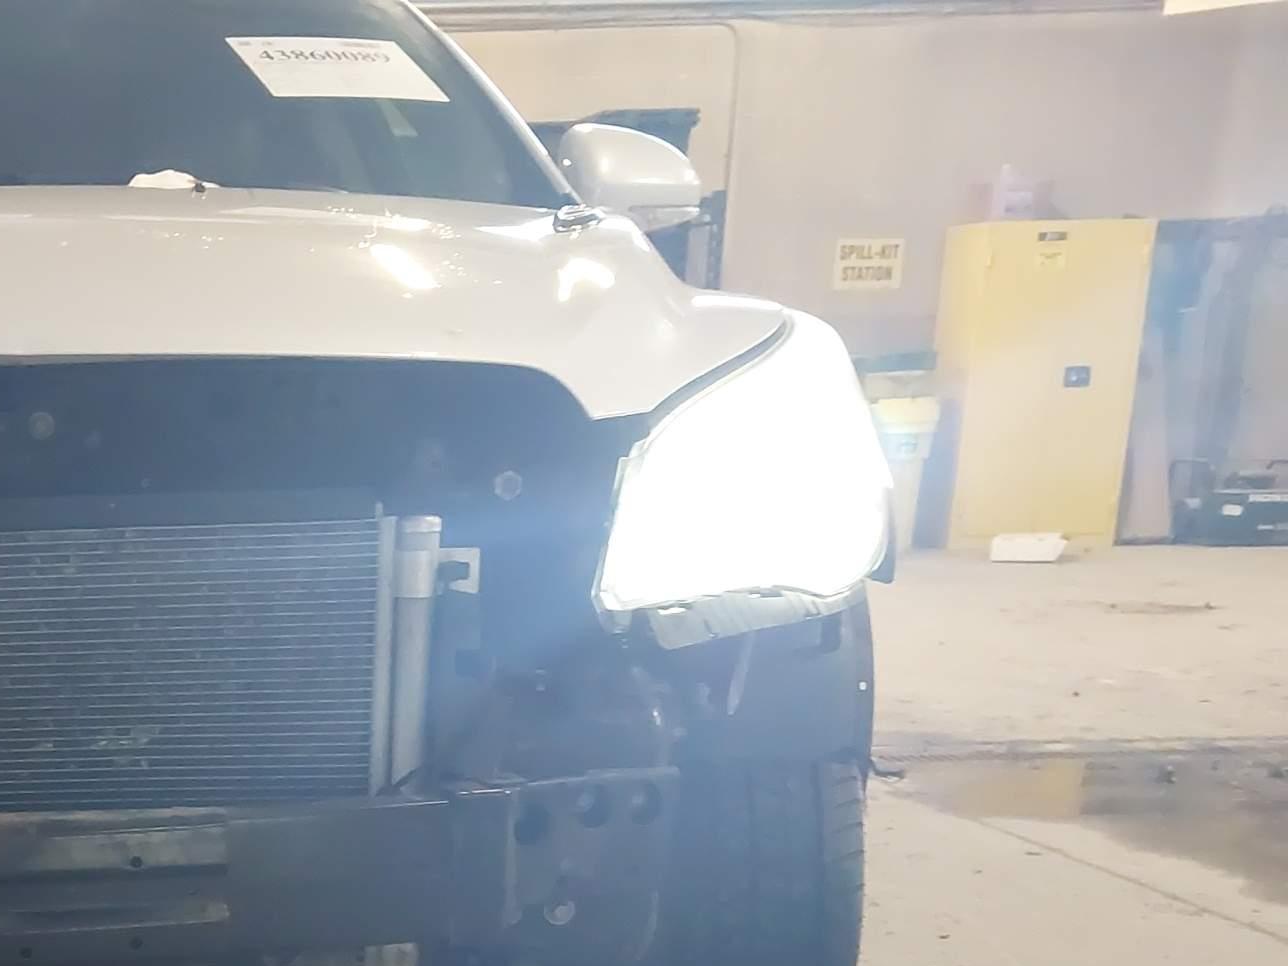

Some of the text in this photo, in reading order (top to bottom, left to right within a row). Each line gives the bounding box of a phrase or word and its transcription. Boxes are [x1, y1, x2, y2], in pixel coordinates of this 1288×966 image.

[259, 49, 391, 65] 43860089
[839, 243, 900, 260] SPILL-KIT
[841, 265, 893, 281] STATION
